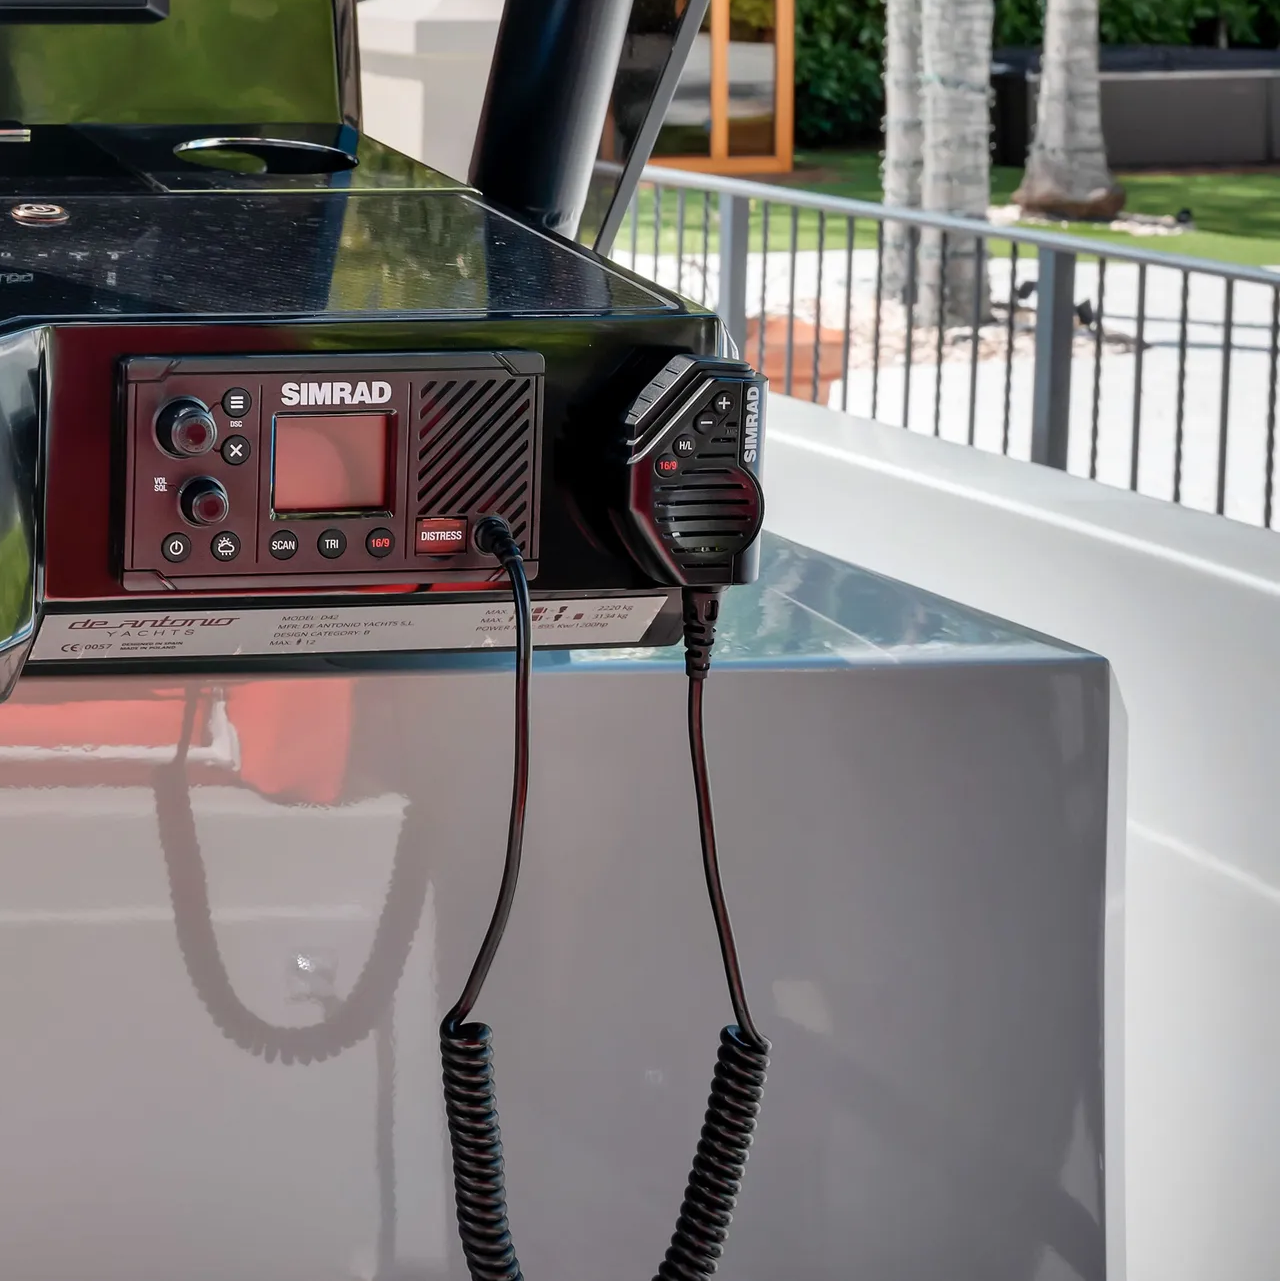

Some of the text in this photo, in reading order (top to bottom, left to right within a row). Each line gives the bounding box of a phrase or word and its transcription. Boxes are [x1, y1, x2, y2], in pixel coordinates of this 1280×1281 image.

[281, 381, 392, 406] SIMRAD
[744, 386, 760, 464] SIMRAD
[679, 441, 693, 451] H/L
[659, 461, 678, 470] 16/9
[154, 477, 168, 485] VOL
[421, 531, 462, 541] DISTRESS
[271, 540, 295, 551] SCAN
[324, 539, 339, 550] TRI
[371, 538, 390, 548] 16/9
[316, 621, 361, 629] ANTONIO
[362, 620, 399, 628] YACHTS
[106, 629, 195, 638] YACHTS
